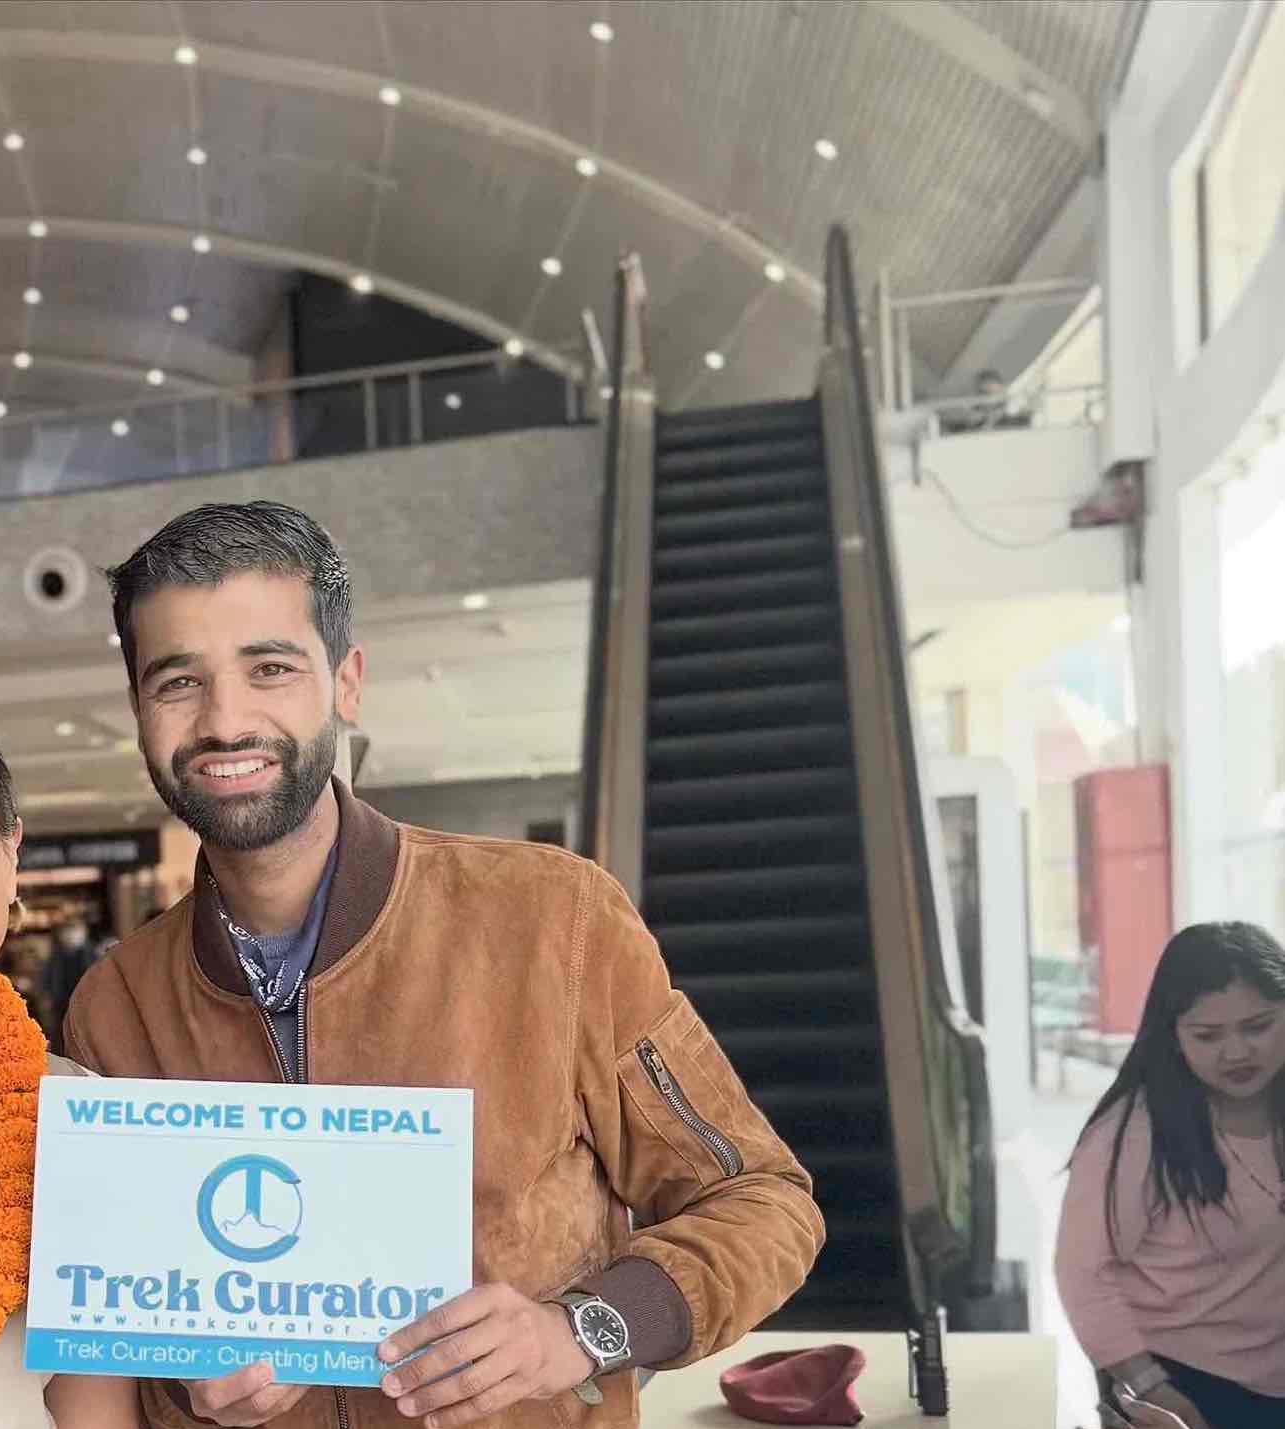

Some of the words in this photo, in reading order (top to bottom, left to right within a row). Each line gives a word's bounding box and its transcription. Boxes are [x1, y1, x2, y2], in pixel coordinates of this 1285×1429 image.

[67, 1099, 244, 1130] WELCOME
[259, 1106, 307, 1133] TO
[322, 1108, 442, 1135] NEPAL
[56, 1264, 202, 1312] Trek
[214, 1270, 444, 1320] Curator
[70, 1313, 388, 1337] www.trekcurator.c
[54, 1338, 102, 1361] Trek
[111, 1340, 202, 1364] Curator
[218, 1345, 317, 1371] Curating
